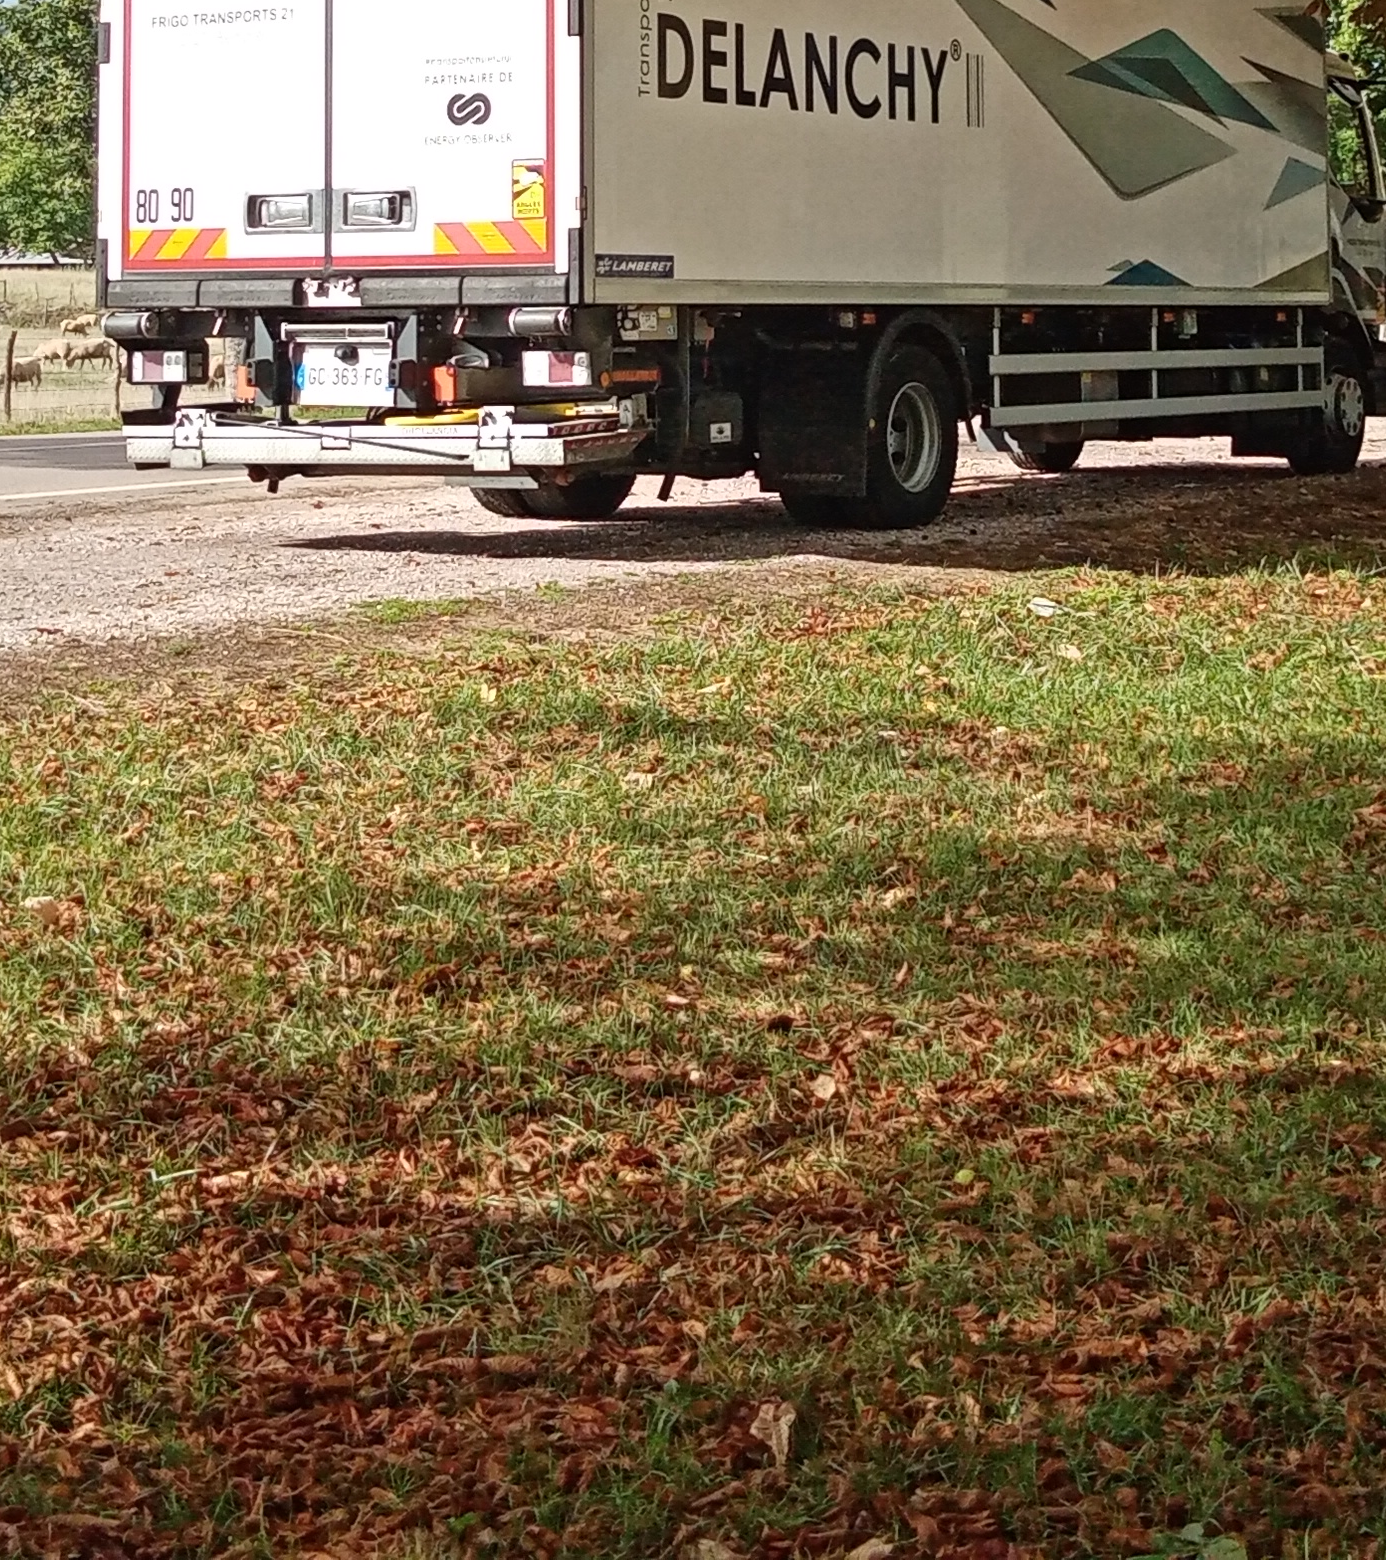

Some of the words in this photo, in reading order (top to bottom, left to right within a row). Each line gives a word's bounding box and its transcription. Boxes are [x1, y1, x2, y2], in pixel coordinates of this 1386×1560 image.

[151, 14, 190, 29] FRIGO
[193, 8, 278, 26] TRANSPORTS
[281, 7, 295, 21] 21
[424, 72, 494, 86] PARTENAIRE
[499, 71, 513, 83] DE
[136, 188, 160, 224] 80
[170, 186, 195, 223] 90
[612, 260, 673, 273] LAMBERET
